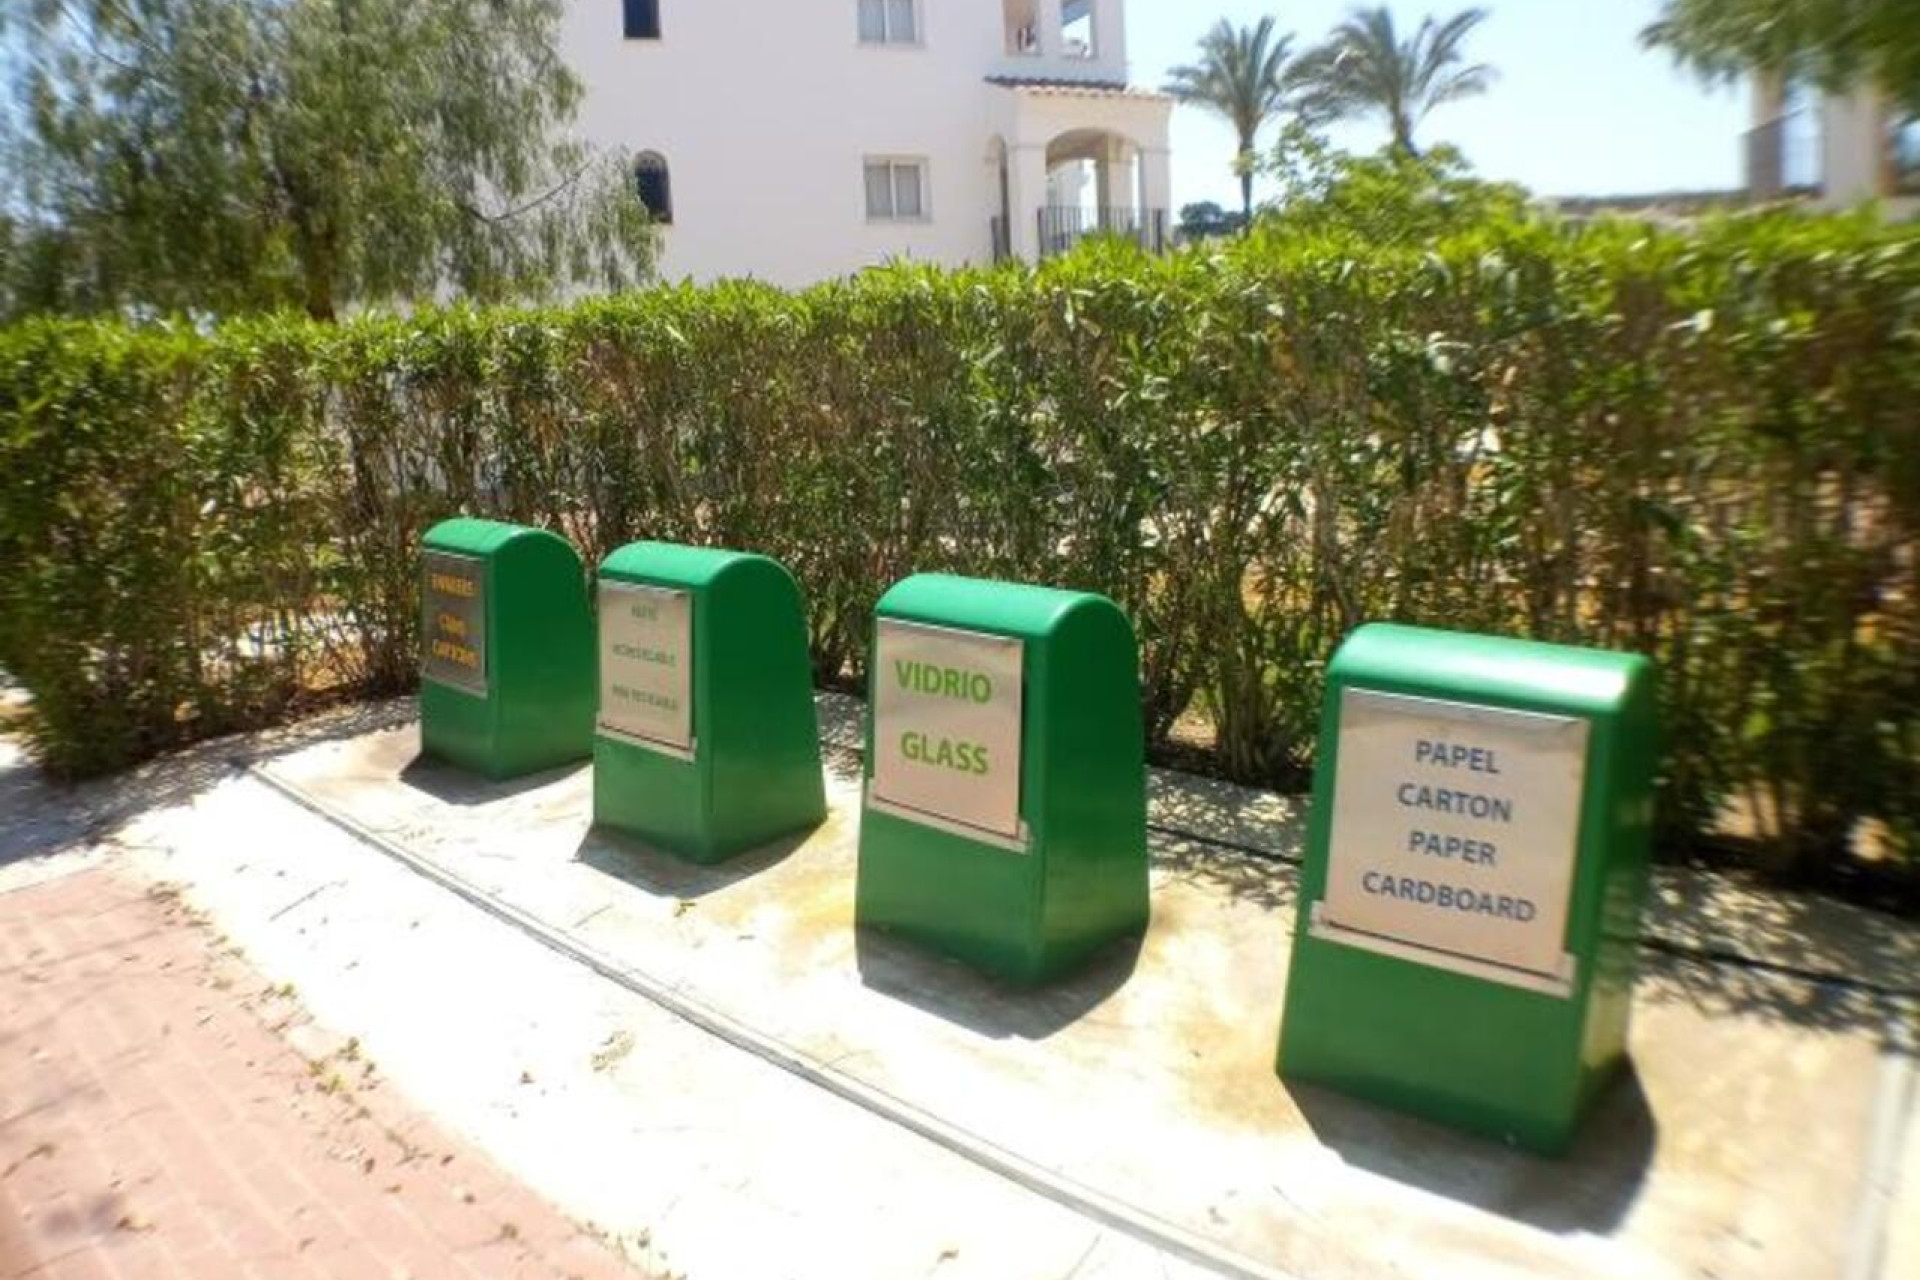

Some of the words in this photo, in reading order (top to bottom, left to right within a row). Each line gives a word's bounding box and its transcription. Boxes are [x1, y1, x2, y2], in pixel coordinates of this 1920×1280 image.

[895, 660, 992, 704] VIDRIO
[901, 731, 989, 774] GLASS
[1415, 740, 1500, 774] PAPEL
[1396, 783, 1512, 822] CARTON
[1407, 830, 1497, 867] PAPER
[1362, 872, 1537, 922] CARDBOARD
